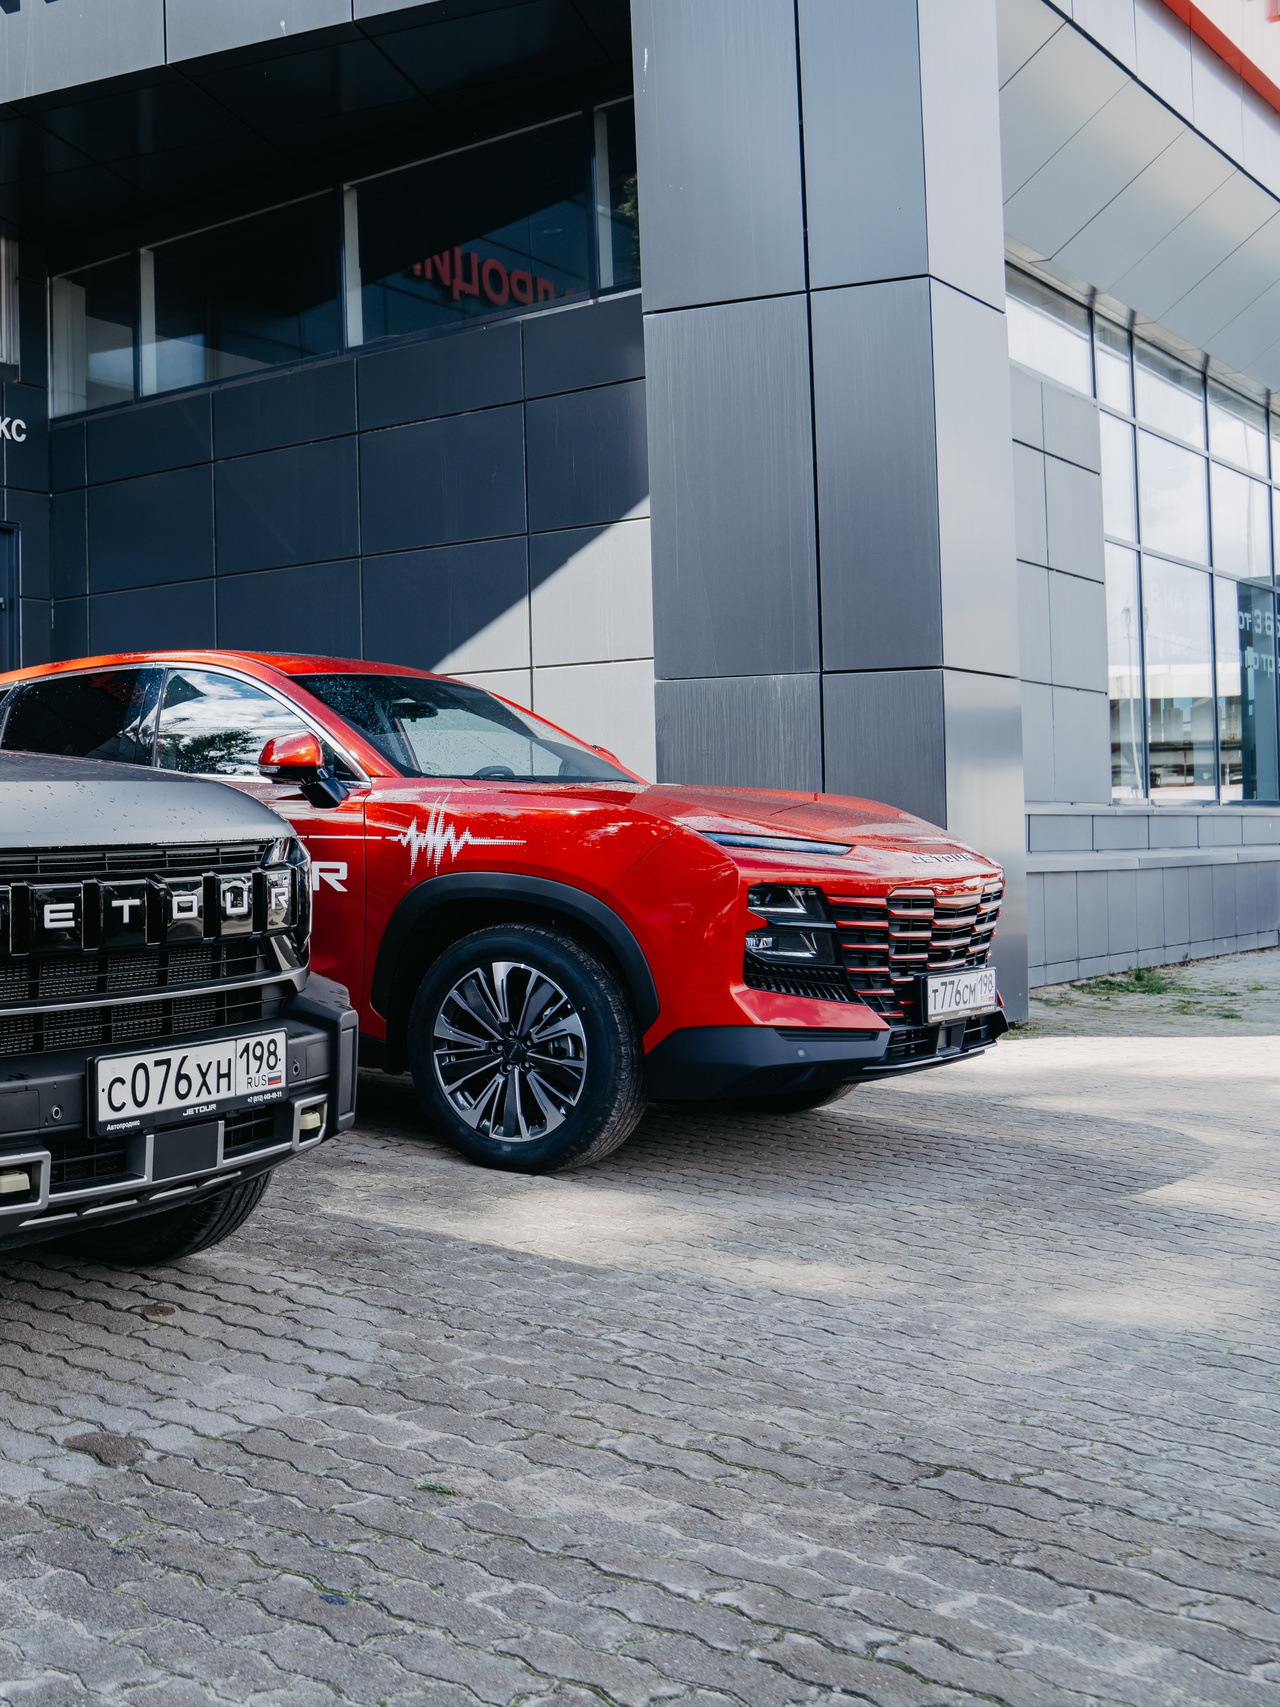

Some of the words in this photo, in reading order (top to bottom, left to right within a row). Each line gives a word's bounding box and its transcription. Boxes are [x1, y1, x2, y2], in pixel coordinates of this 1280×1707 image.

[107, 1054, 232, 1112] С076ХН
[239, 1037, 278, 1075] 198
[246, 1075, 267, 1089] RUS
[182, 1103, 217, 1116] JETOUR
[106, 1120, 140, 1132] Автопродикс
